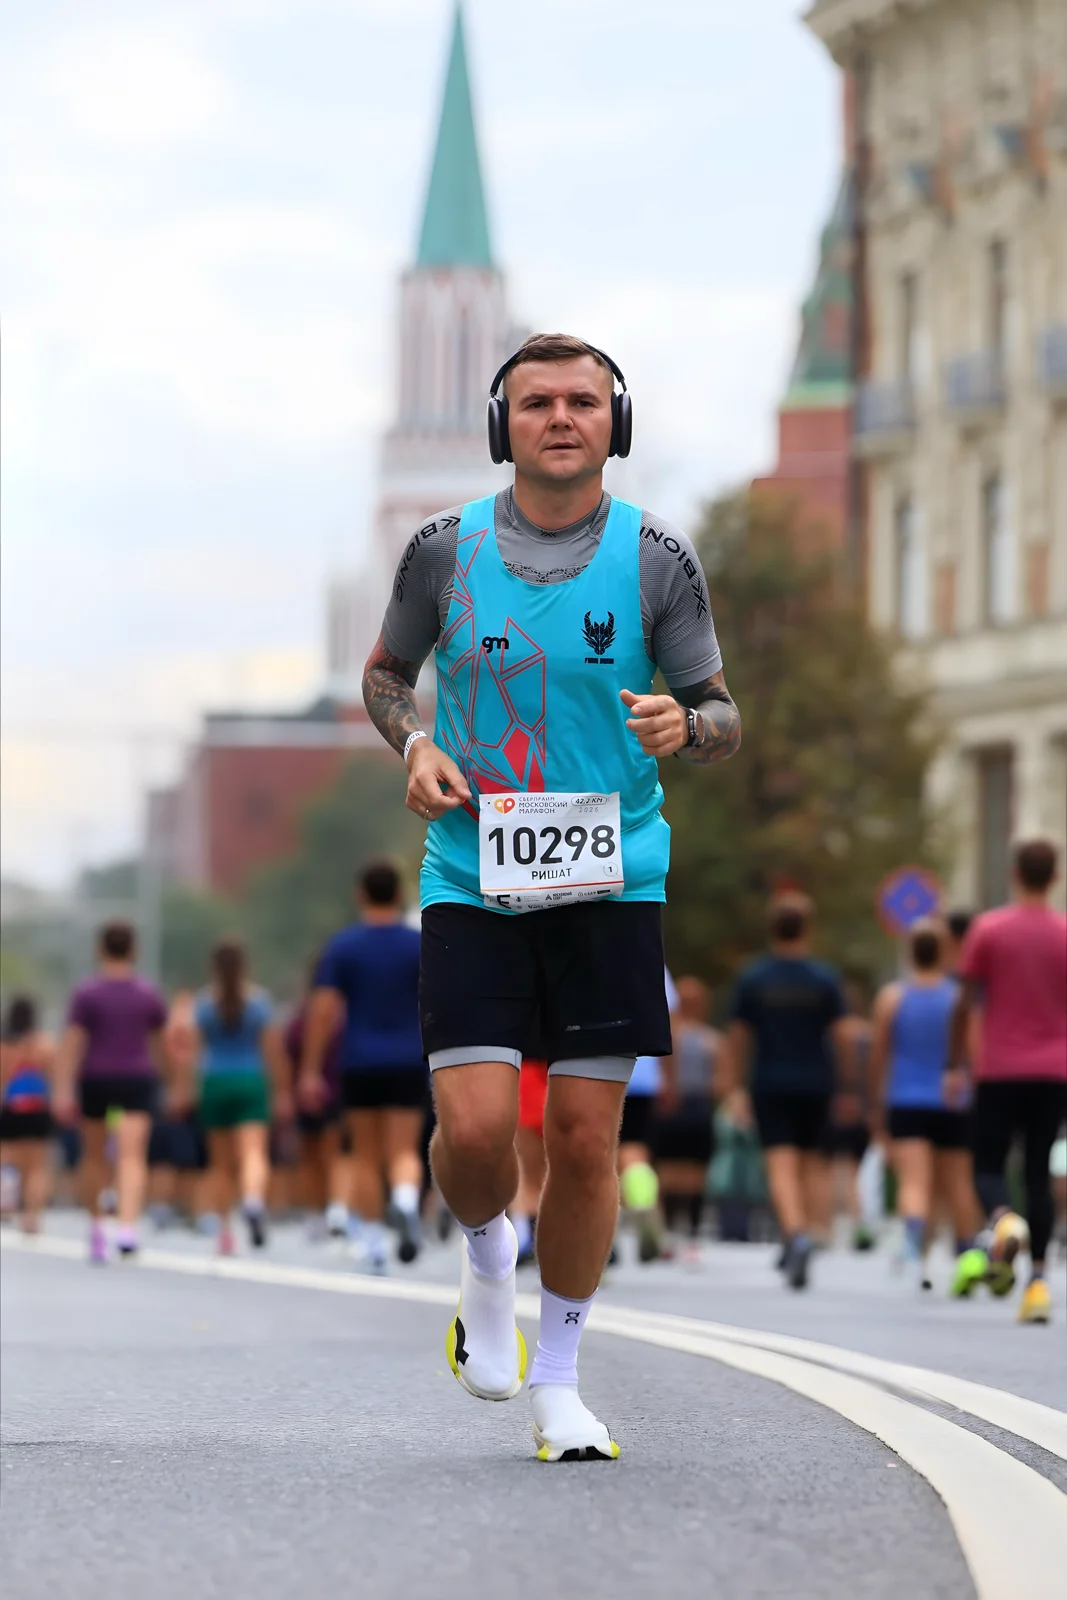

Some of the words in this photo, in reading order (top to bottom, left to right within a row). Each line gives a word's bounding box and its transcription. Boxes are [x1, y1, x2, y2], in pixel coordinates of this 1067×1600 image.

[639, 526, 697, 580] BIONI
[488, 824, 616, 866] 10298
[531, 867, 573, 880] РИШАТ
